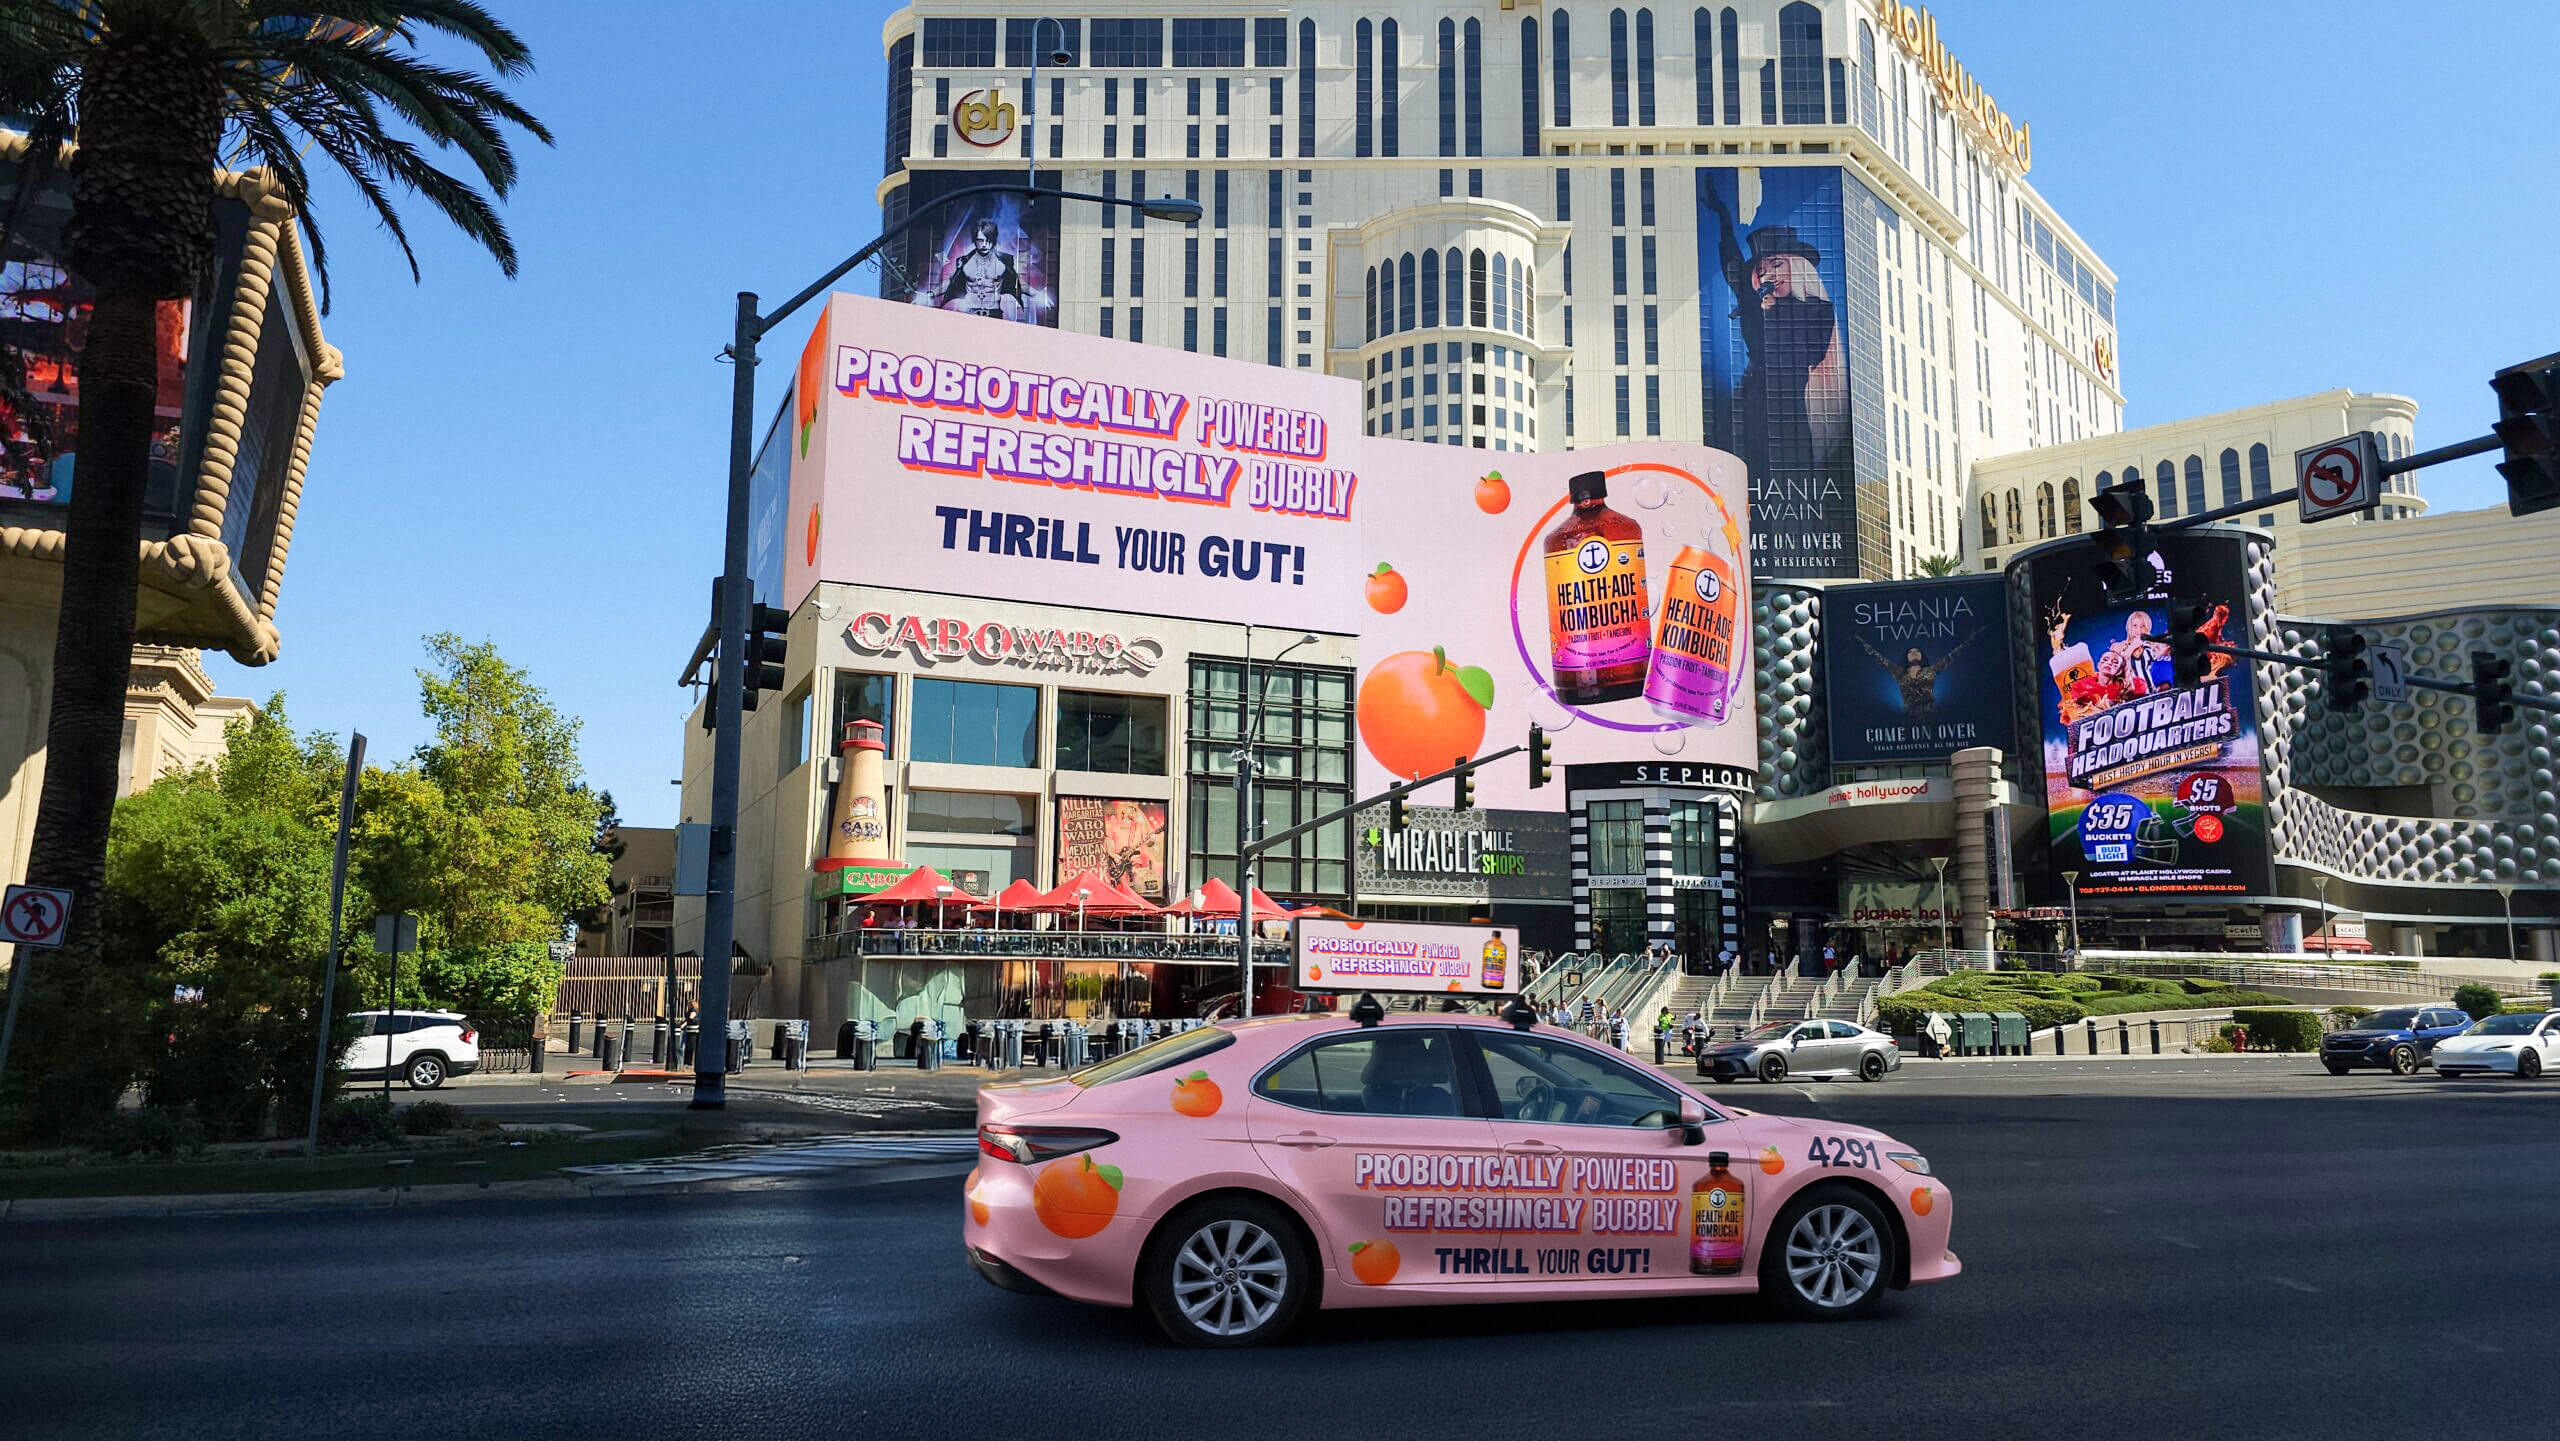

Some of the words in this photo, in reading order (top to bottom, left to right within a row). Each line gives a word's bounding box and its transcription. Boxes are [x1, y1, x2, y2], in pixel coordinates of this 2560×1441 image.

[959, 89, 1015, 133] ph
[1197, 396, 1327, 462] POWERED
[1249, 459, 1357, 521] BUBBLY
[1748, 478, 1842, 500] HANIA
[1774, 533, 1795, 550] ON
[1802, 533, 1842, 550] OVER
[1115, 526, 1185, 576] YOUR
[1199, 535, 1306, 585] GUT!
[1774, 557, 1836, 567] RESIDENCY
[2147, 592, 2168, 600] BAR
[1560, 599, 1639, 632] KOMBUCHA
[1854, 596, 1974, 625] SHANIA
[848, 610, 1014, 664] CABO
[1012, 624, 1124, 659] WABO
[1874, 621, 1956, 642] TWAIN
[1660, 623, 1729, 667] KOMBUCHA
[2378, 685, 2401, 697] ONLY
[2078, 684, 2223, 753] FOOTBALL
[1866, 727, 1906, 743] COME
[1911, 725, 1931, 740] ON
[1938, 723, 1976, 739] OVER
[2071, 713, 2232, 778] HEADQUARTERS
[2098, 773, 2117, 784] BEST
[2119, 762, 2146, 778] HAPPY
[2149, 757, 2171, 770] HOUR
[2174, 753, 2182, 764] IN
[2185, 746, 2212, 761] VEGAS!
[1637, 766, 1752, 791] SEPHORA
[1828, 790, 1853, 807] planet
[1857, 783, 1928, 800] hollywood
[2190, 778, 2218, 803] $5
[1062, 799, 1103, 811] KILLER
[1064, 820, 1104, 832] CABO
[2085, 803, 2133, 831] $35
[1064, 830, 1105, 841] WABO
[2085, 833, 2132, 841] BUCKETS
[1066, 844, 1107, 857] MEXICAN
[1383, 827, 1481, 874] MIRACLE
[1482, 831, 1513, 852] MILE
[2098, 852, 2126, 861] LIGHT
[1066, 855, 1097, 869] FOOD
[1482, 854, 1525, 875] SHOPS
[847, 872, 900, 888] CABO
[1591, 878, 1645, 886] SEPHORA
[1853, 905, 1912, 923] planet
[1420, 943, 1460, 960] POWERED
[1437, 960, 1471, 978] BUBBLY
[1808, 1136, 1881, 1170] 4291
[1355, 1153, 1568, 1193] PROBIOTICALLY
[1572, 1156, 1679, 1195] POWERED
[1383, 1196, 1588, 1235] REFRESHINGLY
[1591, 1198, 1682, 1237] BUBBLY
[1695, 1224, 1739, 1238] KOMBUCHA
[1434, 1248, 1529, 1274] THRILL
[1537, 1248, 1579, 1274] YOUR
[1587, 1248, 1650, 1274] GUT!
